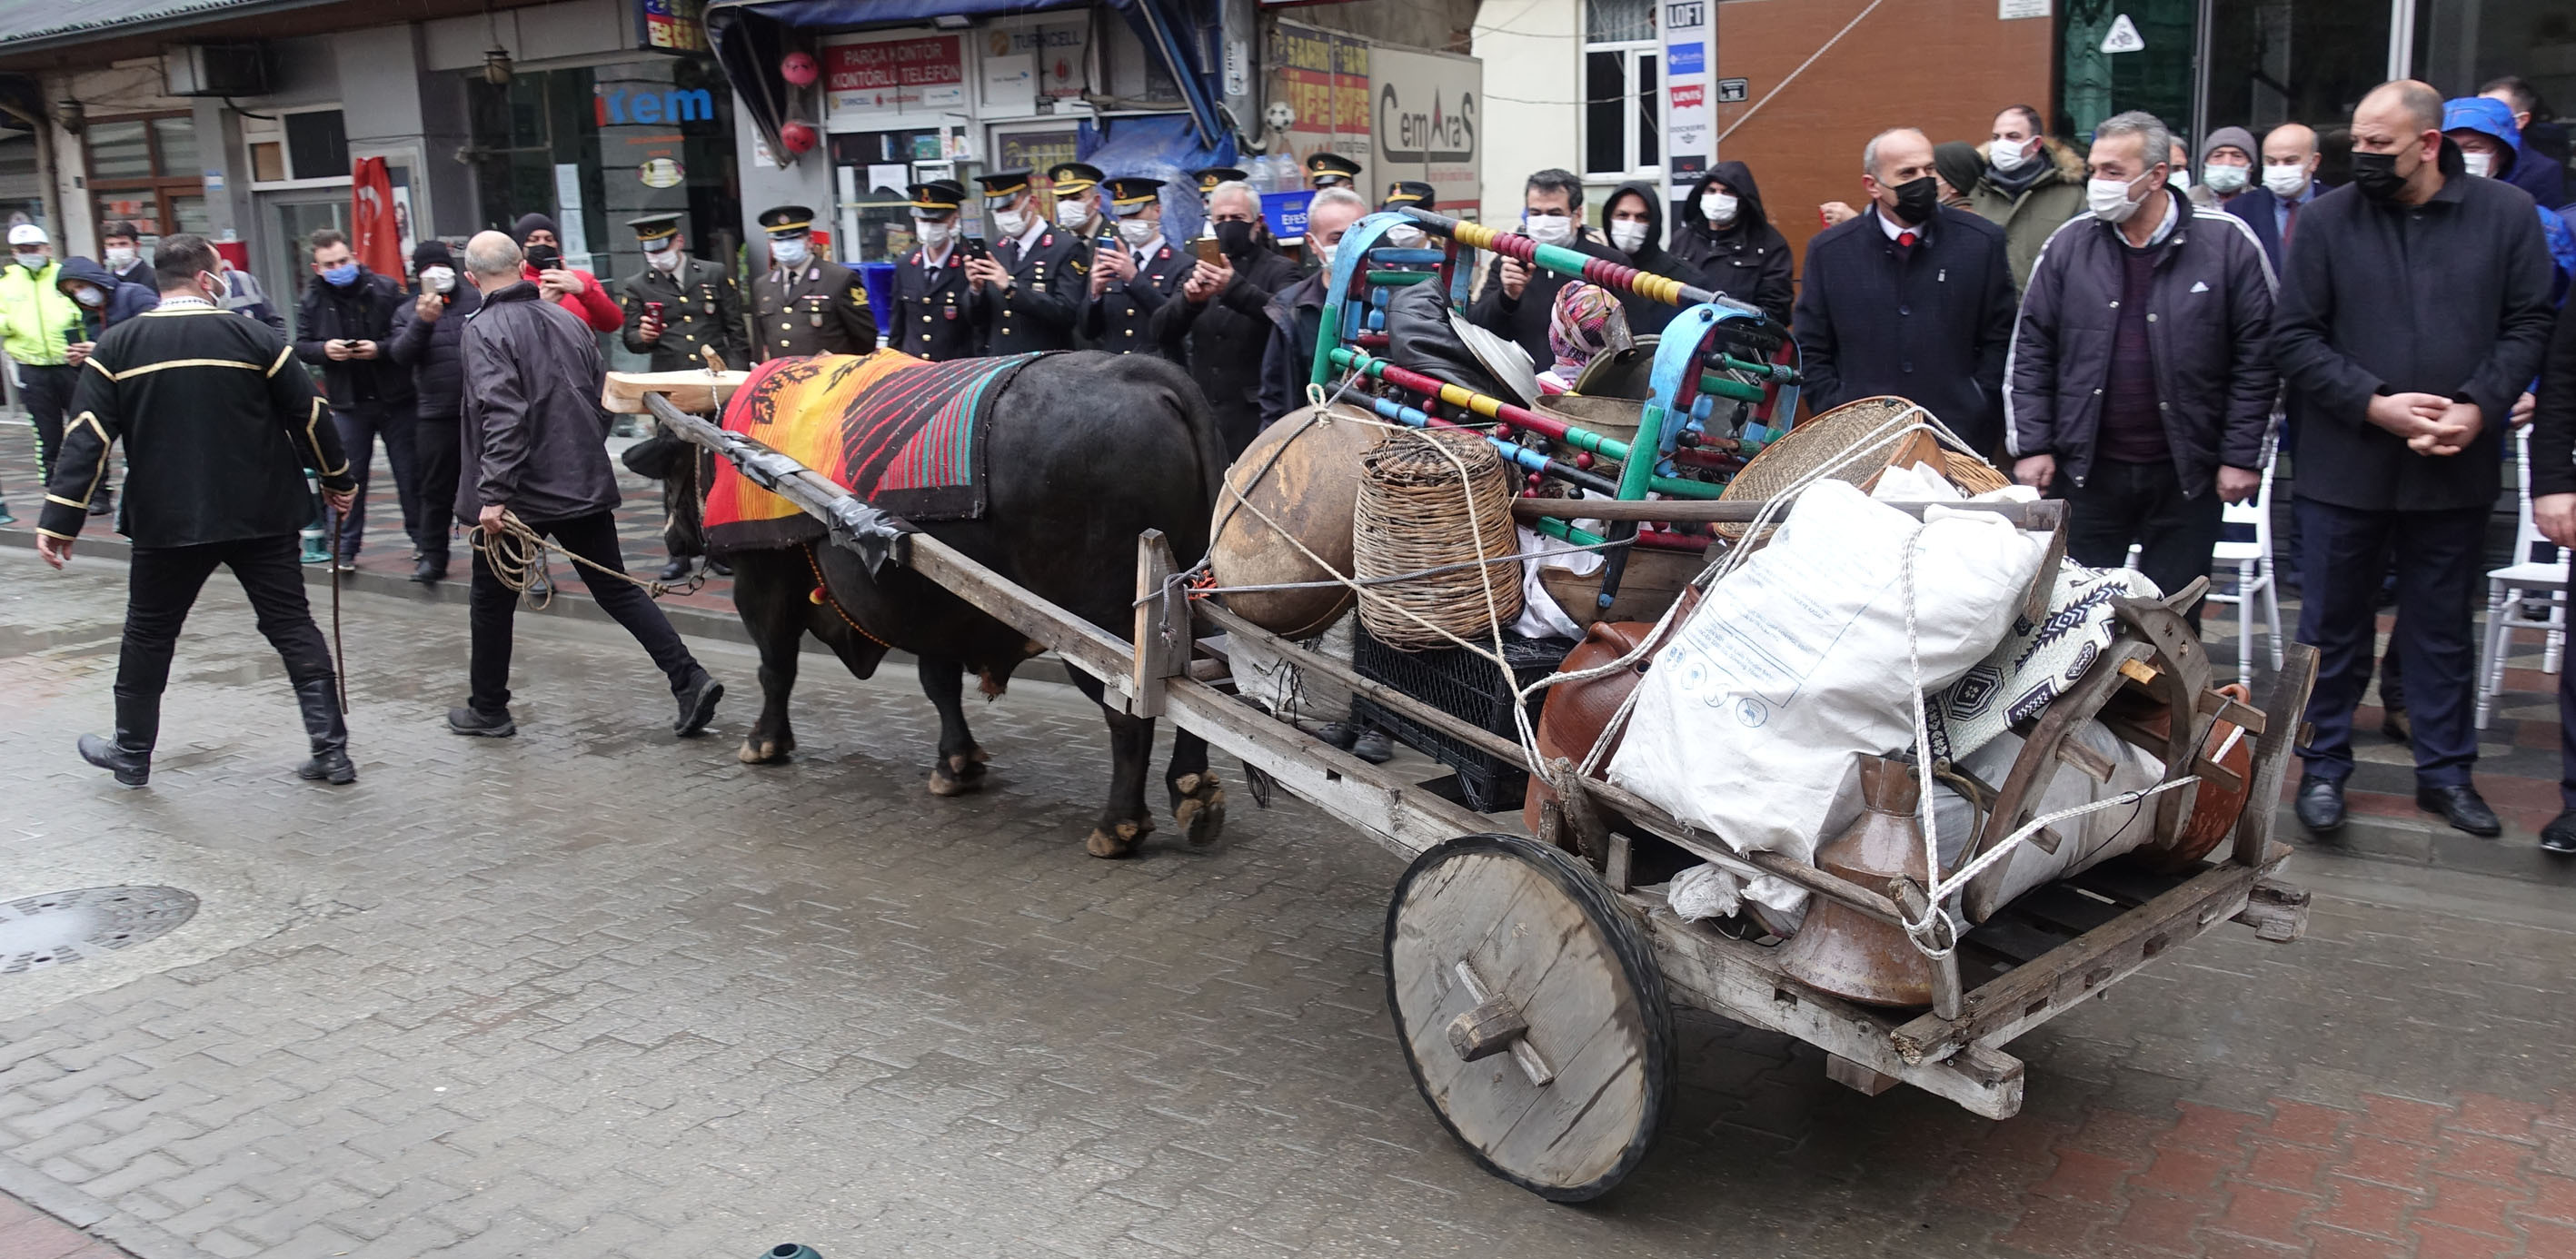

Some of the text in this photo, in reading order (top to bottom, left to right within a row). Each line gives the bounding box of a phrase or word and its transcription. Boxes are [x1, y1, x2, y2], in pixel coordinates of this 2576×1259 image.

[1666, 4, 1703, 27] LOFT
[842, 49, 887, 66] PARÇA
[900, 64, 960, 83] TELEFON
